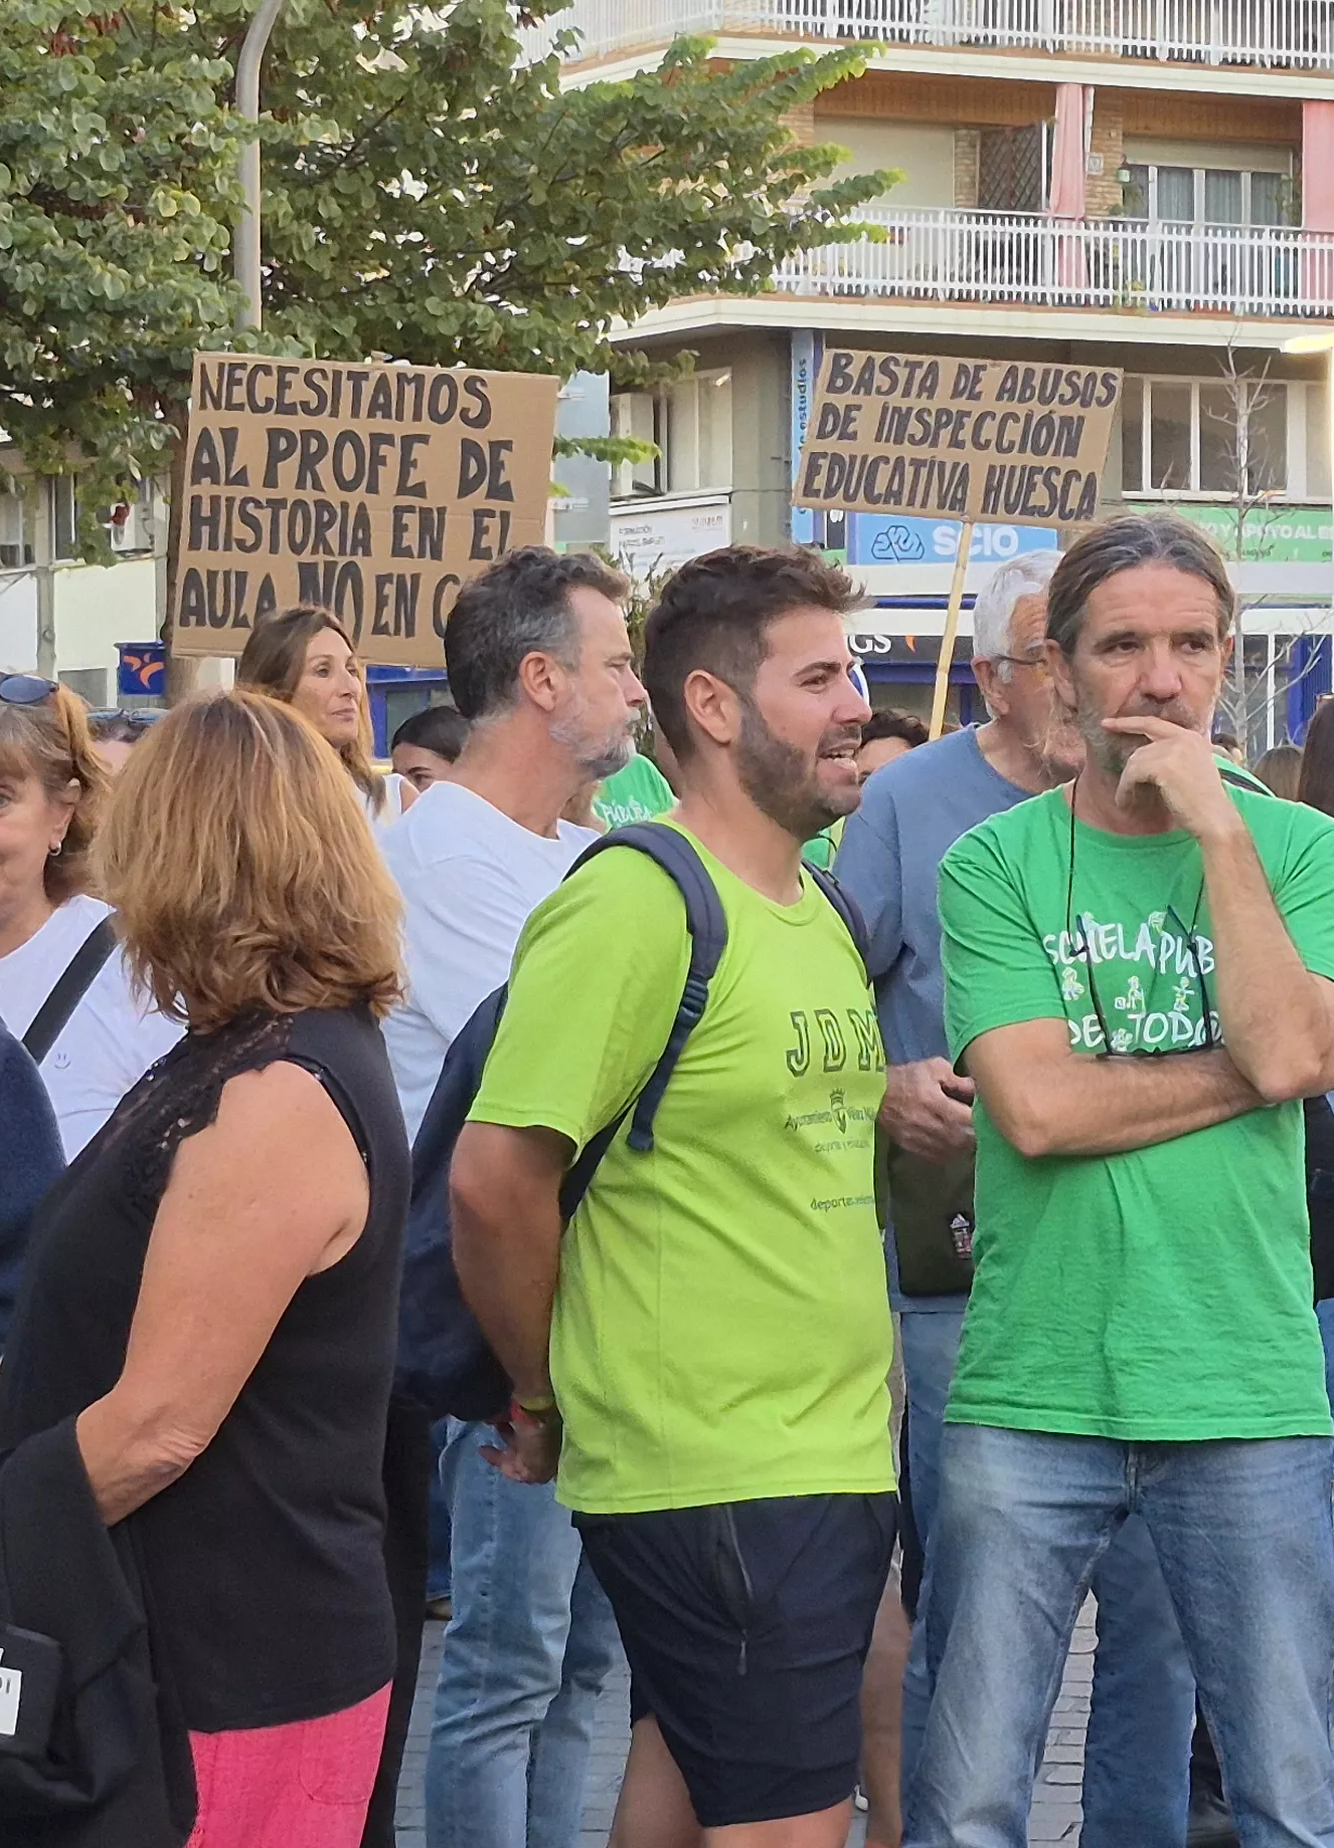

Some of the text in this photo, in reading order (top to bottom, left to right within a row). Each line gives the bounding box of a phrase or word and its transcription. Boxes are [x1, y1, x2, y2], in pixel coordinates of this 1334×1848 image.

[198, 362, 492, 429] NECESITAMOS
[825, 352, 1118, 409] BASTA DE ABUSOS
[816, 402, 862, 441] DE
[190, 426, 514, 502] AL PROFE DE
[981, 464, 1097, 521] HUESCA
[188, 494, 372, 557] HISTORIA
[391, 505, 447, 560] EN
[933, 525, 1018, 556] SCIO
[179, 567, 277, 629] AULA
[371, 572, 422, 639] EN
